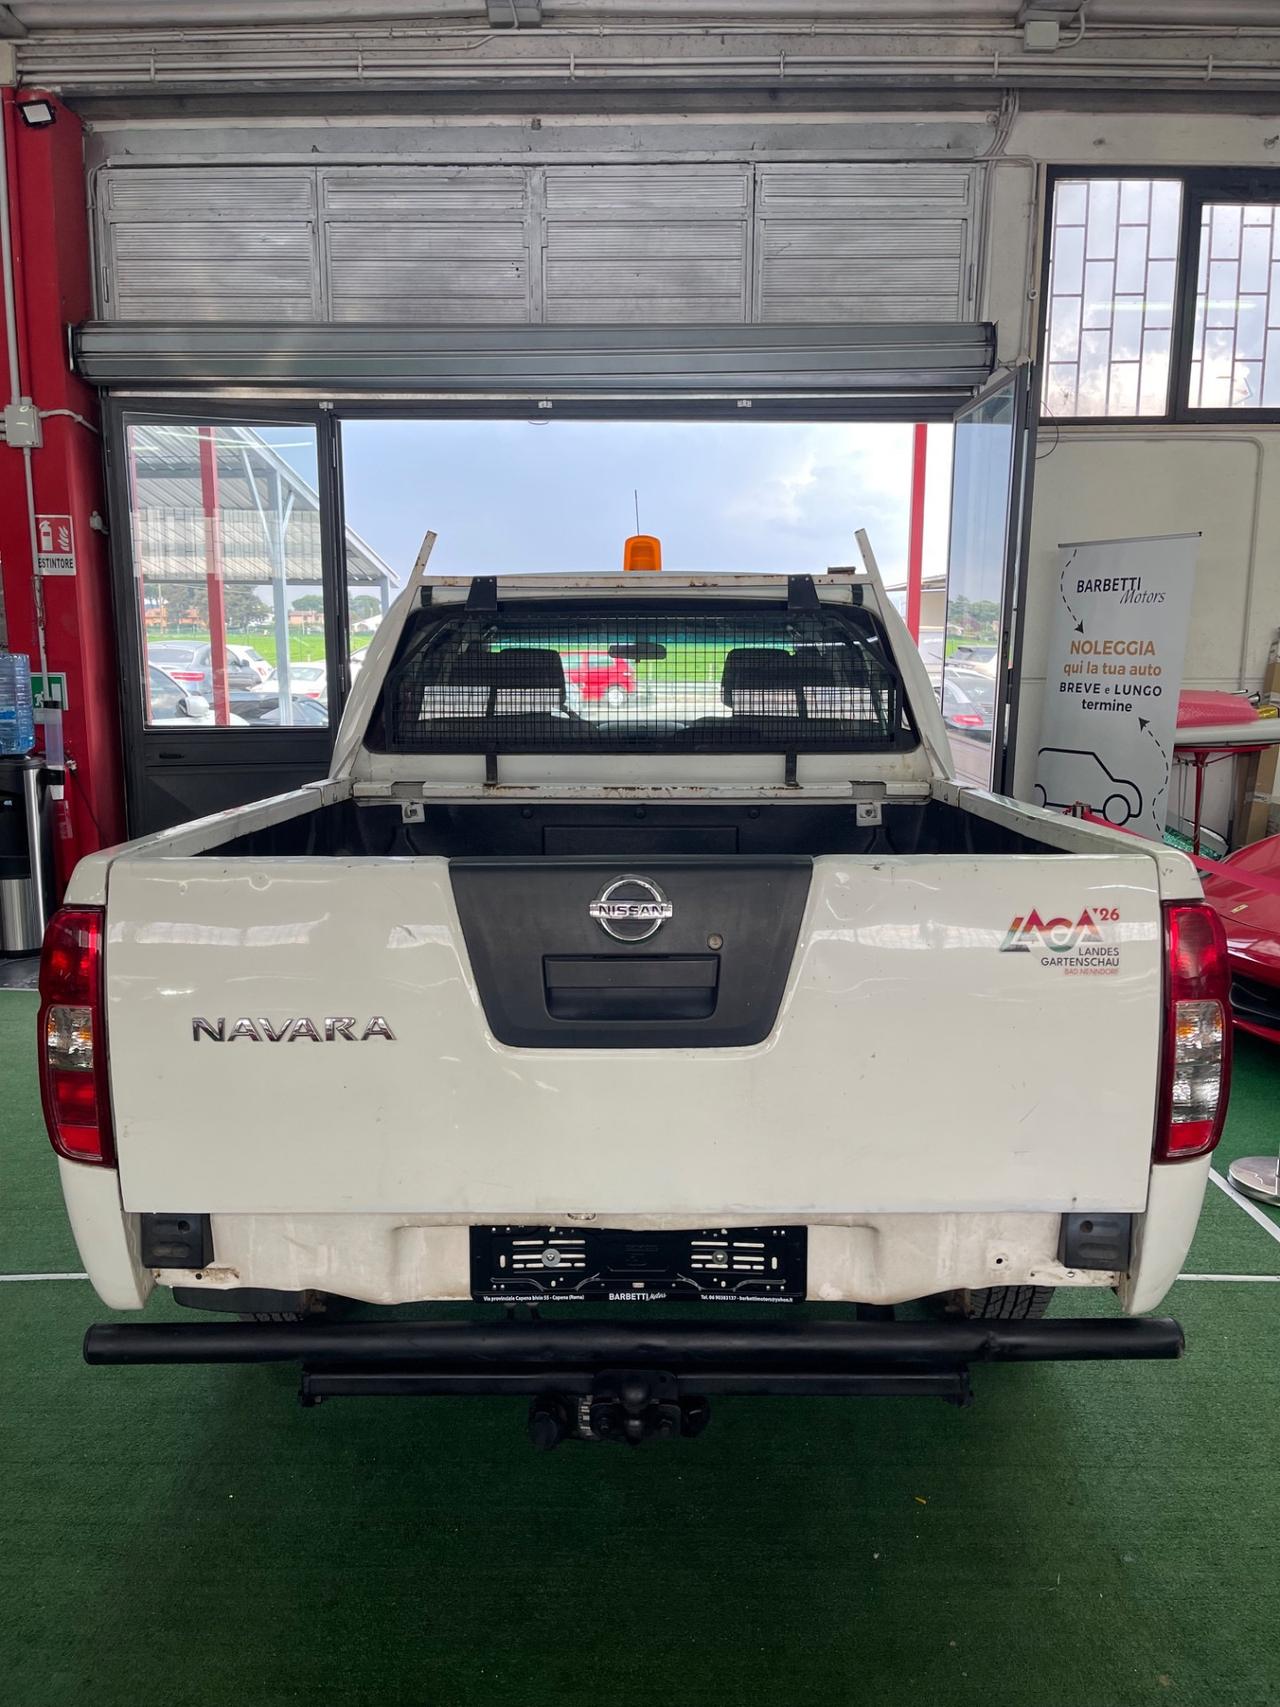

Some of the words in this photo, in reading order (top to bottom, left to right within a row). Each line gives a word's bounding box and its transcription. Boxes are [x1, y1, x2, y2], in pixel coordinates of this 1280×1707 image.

[38, 558, 74, 569] ESTINTORE
[1076, 577, 1141, 593] BARBETTI
[1119, 589, 1166, 605] Motors
[1070, 640, 1156, 656] NOLEGGIA
[1063, 660, 1084, 677] qui
[1086, 661, 1098, 674] la
[1102, 663, 1126, 676] tua
[1129, 663, 1162, 677] auto
[1059, 682, 1101, 694] BREVE
[1114, 684, 1162, 697] LUNGO
[1081, 699, 1133, 712] termine
[598, 904, 665, 916] NISSAN
[1078, 947, 1120, 957] LANDES
[1040, 957, 1120, 967] GARTENSCHAU
[192, 1016, 397, 1042] NAVARA
[608, 1292, 649, 1301] BARBETTI
